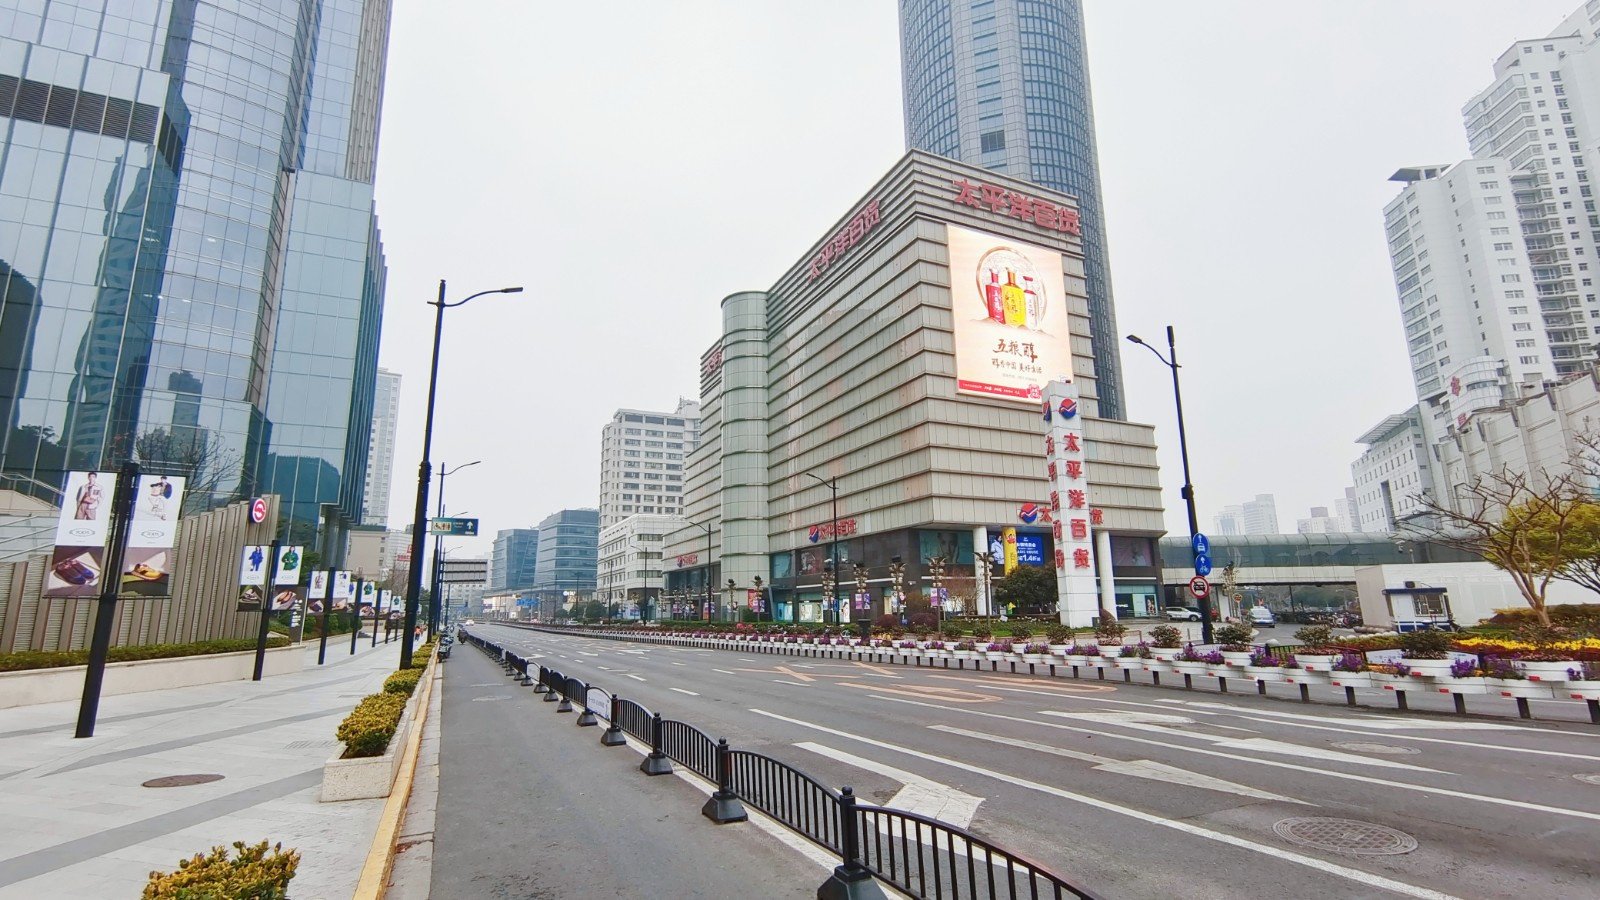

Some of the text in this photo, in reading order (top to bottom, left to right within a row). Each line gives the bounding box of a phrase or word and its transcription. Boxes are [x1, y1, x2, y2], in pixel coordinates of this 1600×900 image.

[804, 198, 881, 285] 太平洋百货
[953, 179, 1080, 236] 太平洋百货
[992, 338, 1038, 363] 五粮醇
[1064, 432, 1091, 569] 太平洋百货
